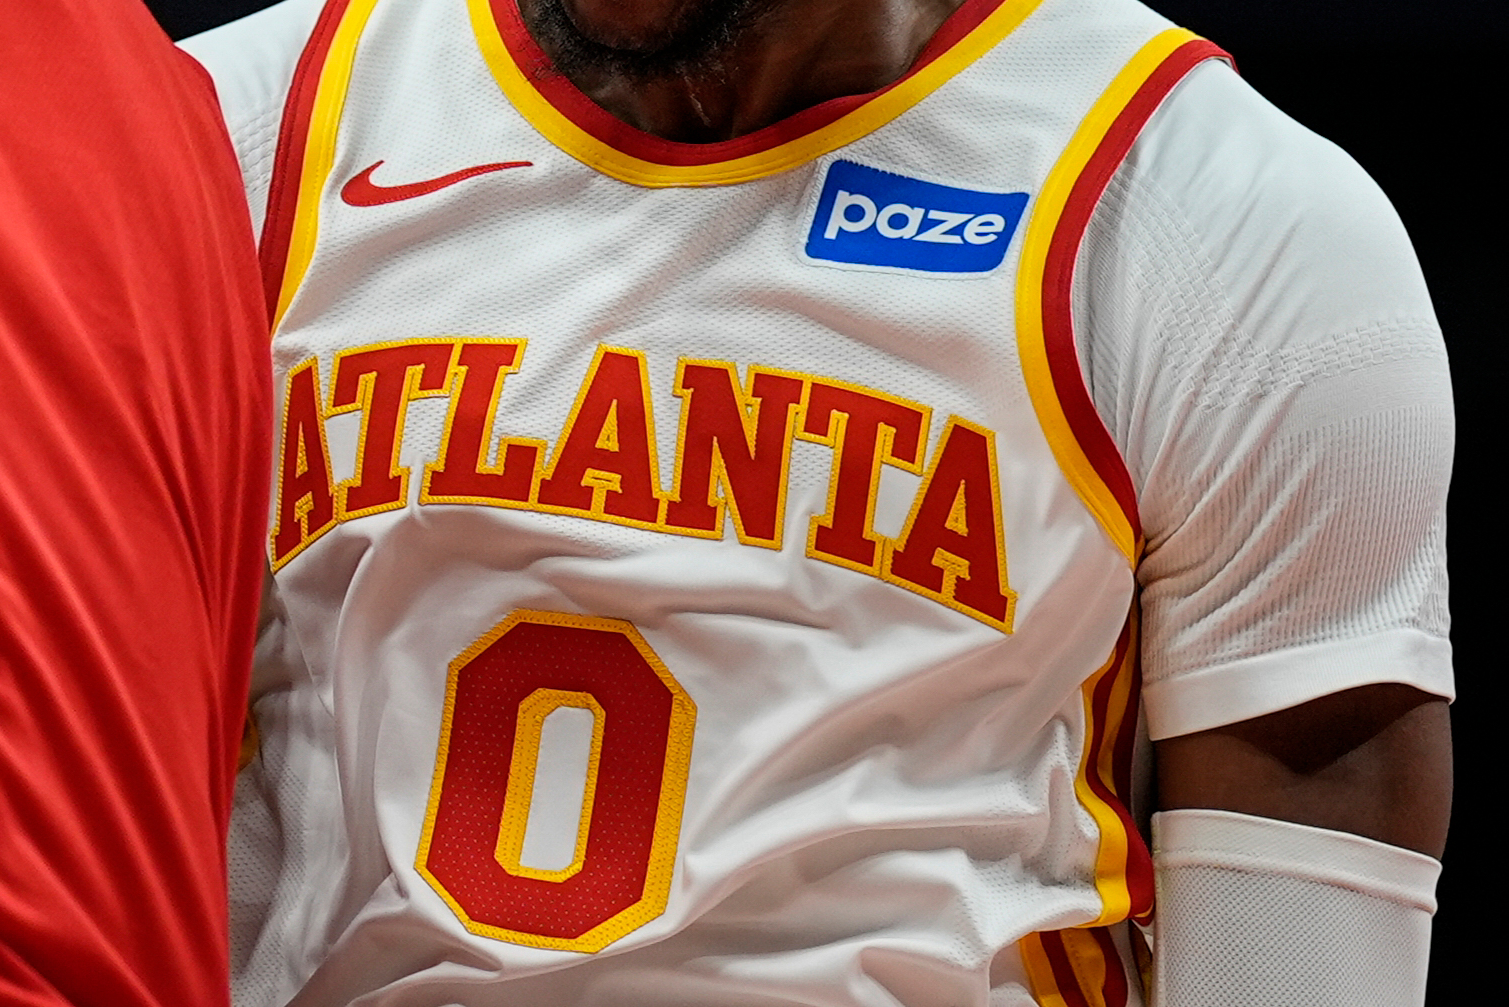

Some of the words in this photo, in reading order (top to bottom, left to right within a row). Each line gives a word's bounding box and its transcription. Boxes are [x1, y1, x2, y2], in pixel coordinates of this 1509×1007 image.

[823, 190, 1006, 245] paze
[270, 338, 1017, 633] ATLANTA
[414, 608, 697, 954] 0
